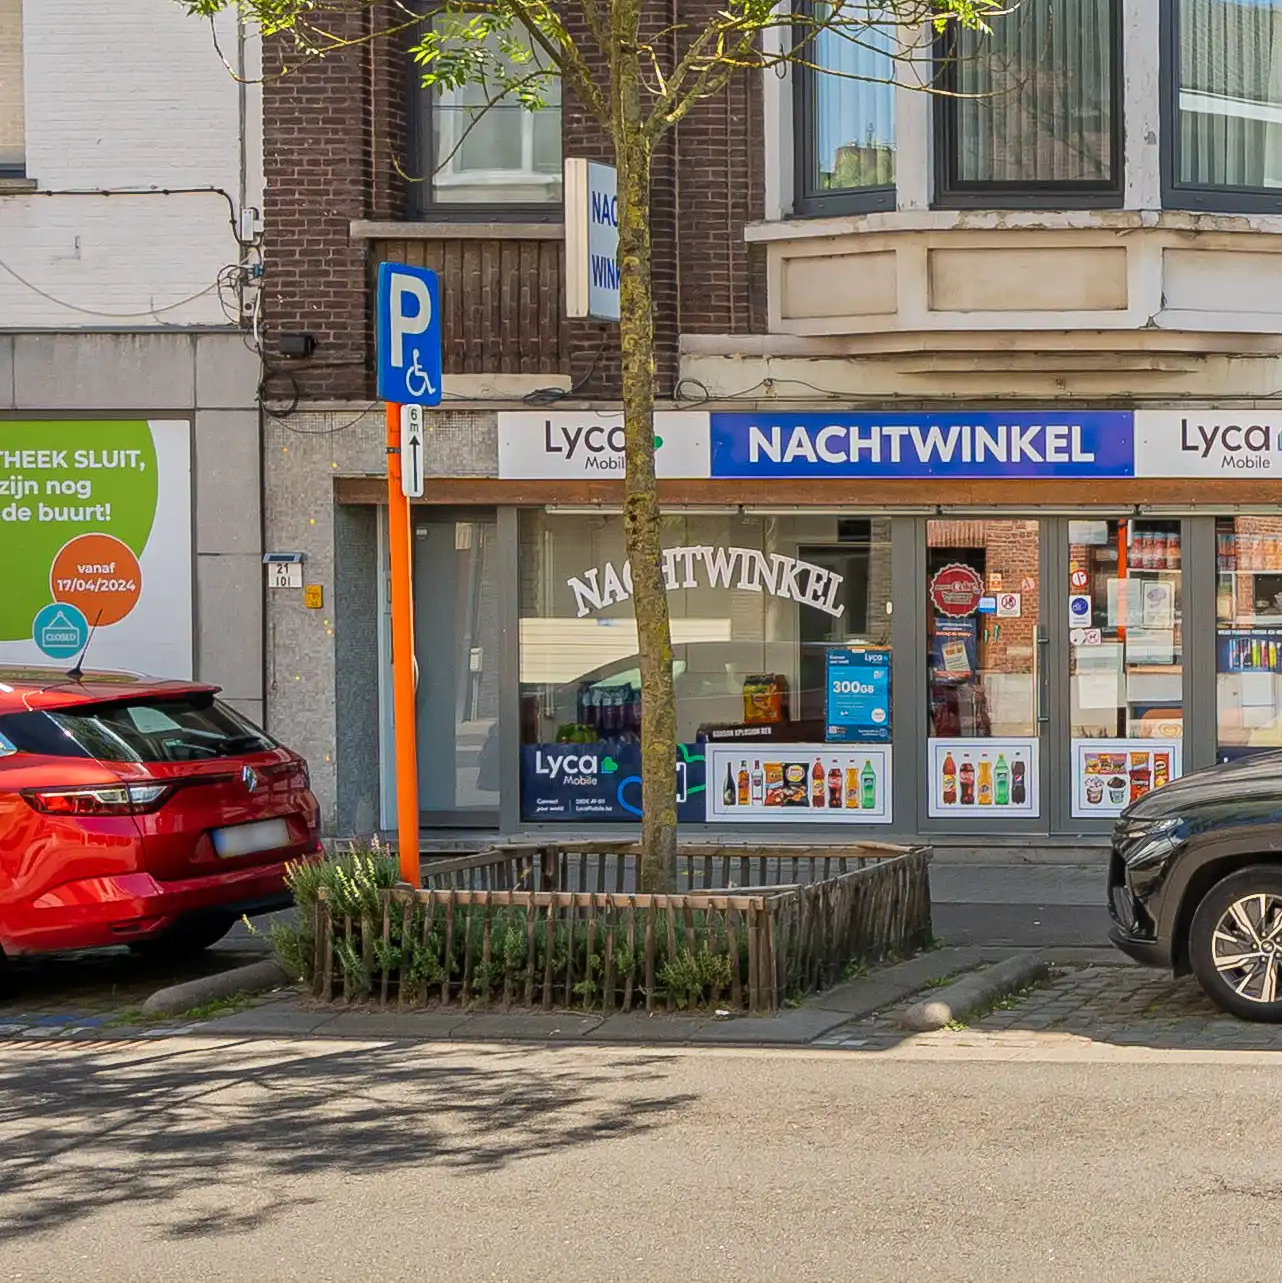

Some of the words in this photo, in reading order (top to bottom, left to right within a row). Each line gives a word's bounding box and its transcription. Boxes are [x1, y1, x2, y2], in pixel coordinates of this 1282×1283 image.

[592, 191, 619, 228] NAC
[390, 273, 432, 367] P
[410, 409, 417, 421] 6
[409, 423, 419, 433] m
[749, 425, 1095, 464] NACHTWINKEL
[1180, 418, 1271, 458] Lyca
[74, 450, 146, 471] SLUIT,
[585, 456, 626, 470] Mobil
[1221, 454, 1271, 469] Mobile
[0, 475, 39, 499] zijn
[46, 481, 91, 499] nog
[1, 503, 32, 521] de
[39, 503, 111, 521] buurt!
[77, 562, 115, 574] vanaf
[57, 579, 136, 592] 17/04/2024
[832, 680, 875, 694] 300GB
[535, 750, 598, 779] Lyca
[563, 775, 598, 786] Mobile
